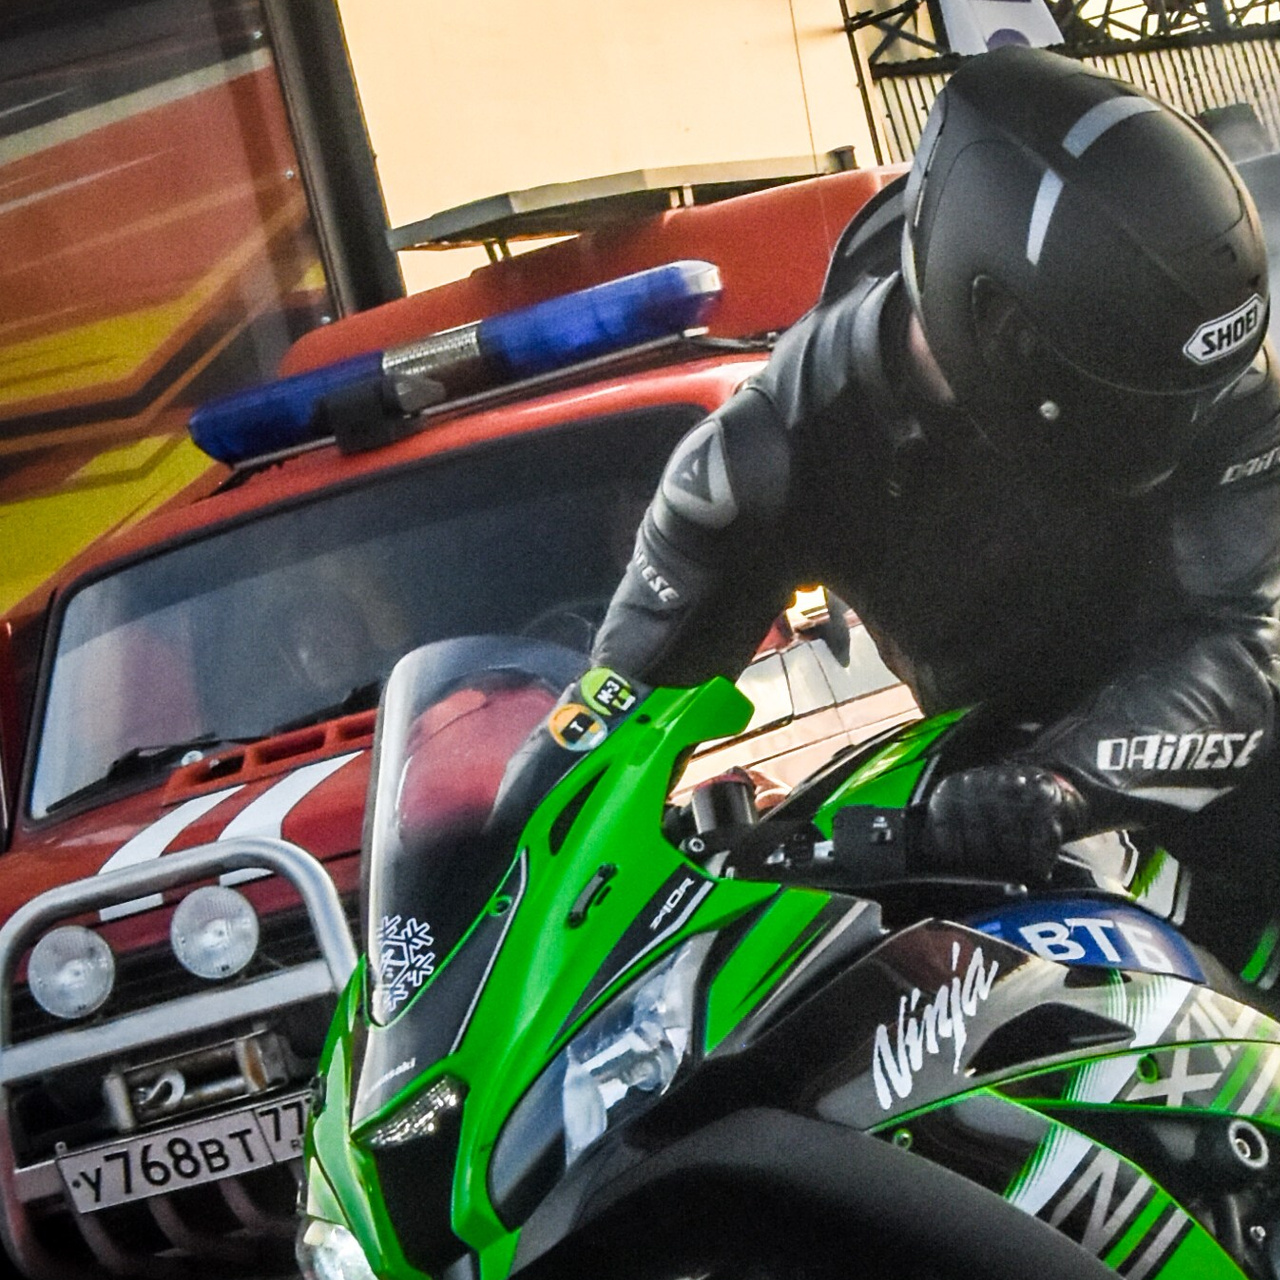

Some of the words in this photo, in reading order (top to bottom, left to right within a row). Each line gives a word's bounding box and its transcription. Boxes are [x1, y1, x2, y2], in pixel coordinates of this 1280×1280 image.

[1201, 304, 1258, 357] SHOEI
[1097, 729, 1264, 771] DAINESE
[1020, 918, 1174, 973] ВТБ
[873, 941, 999, 1111] Ninja
